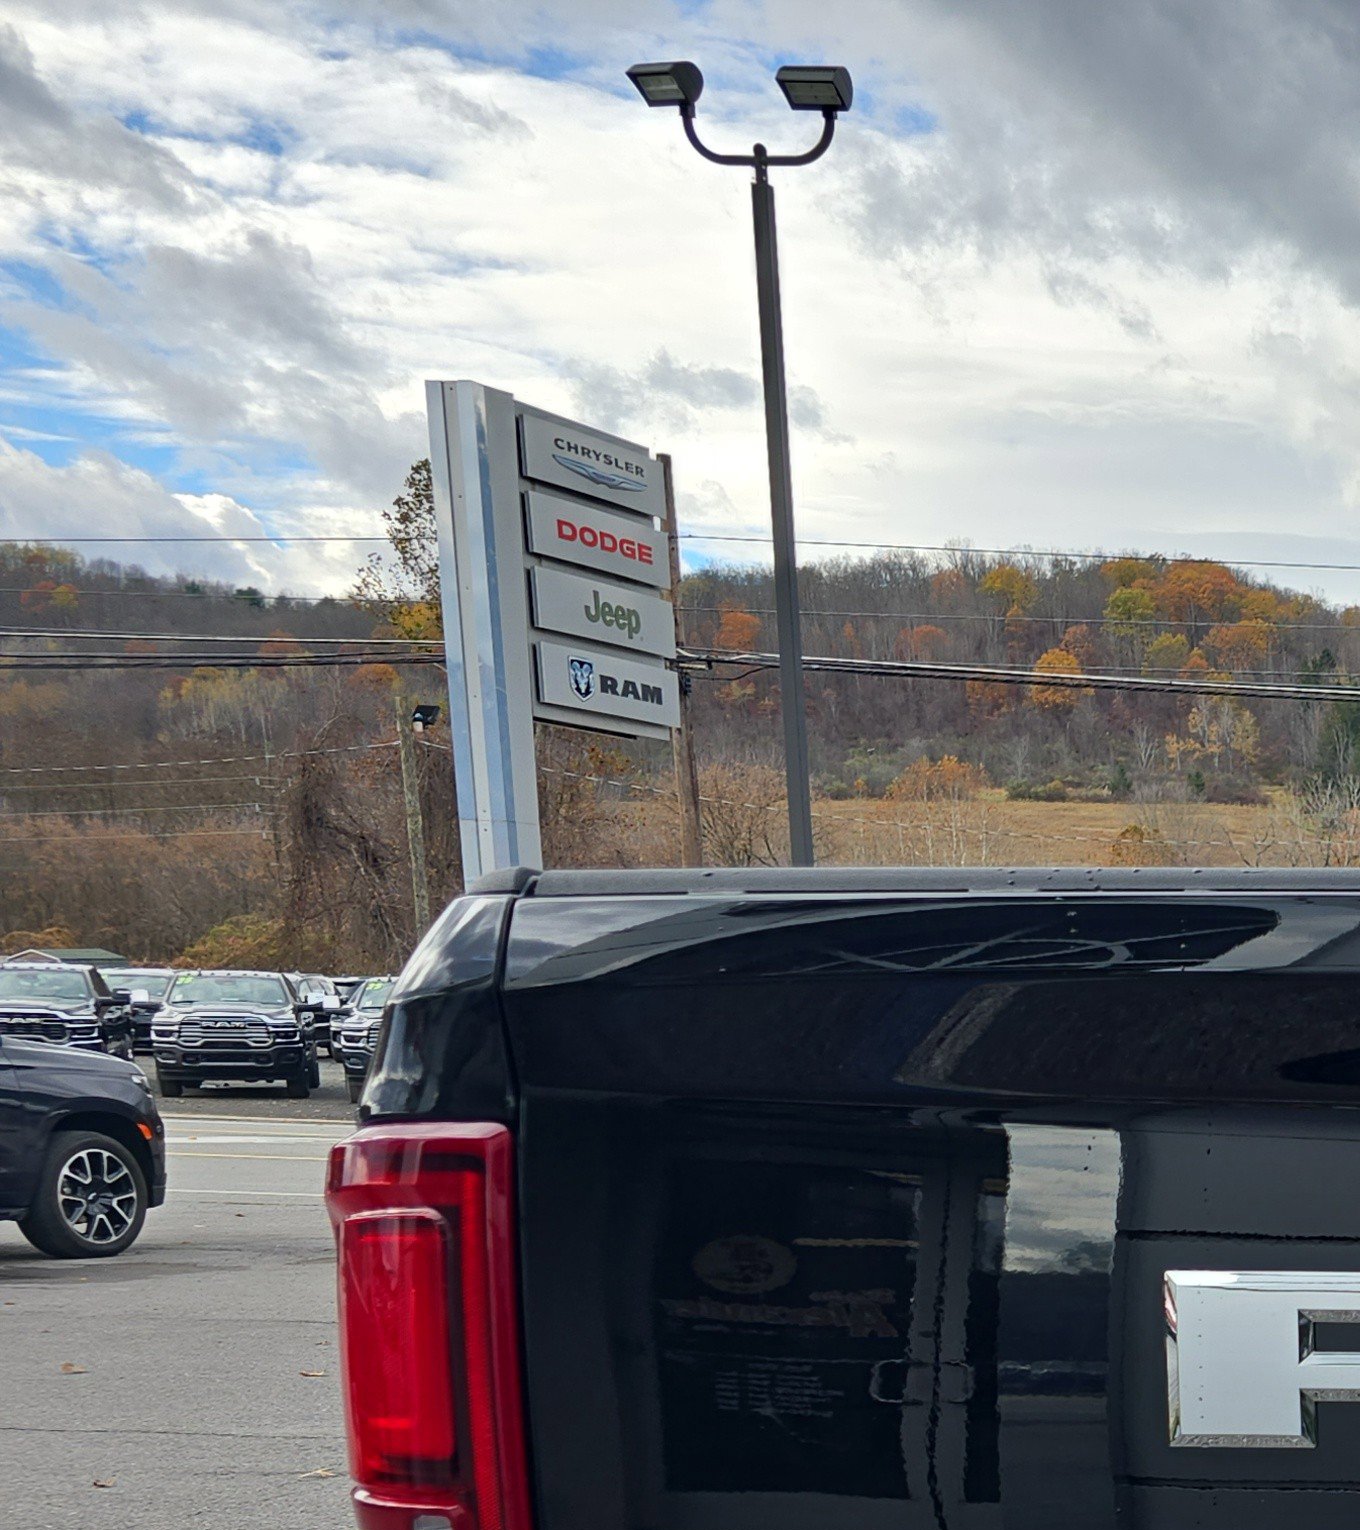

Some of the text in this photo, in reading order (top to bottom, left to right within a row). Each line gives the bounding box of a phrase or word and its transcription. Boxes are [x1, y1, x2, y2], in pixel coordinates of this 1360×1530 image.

[554, 437, 645, 477] CHRYSLER
[556, 518, 654, 565] DODGE
[584, 589, 641, 639] Jeep
[599, 674, 663, 705] RAM
